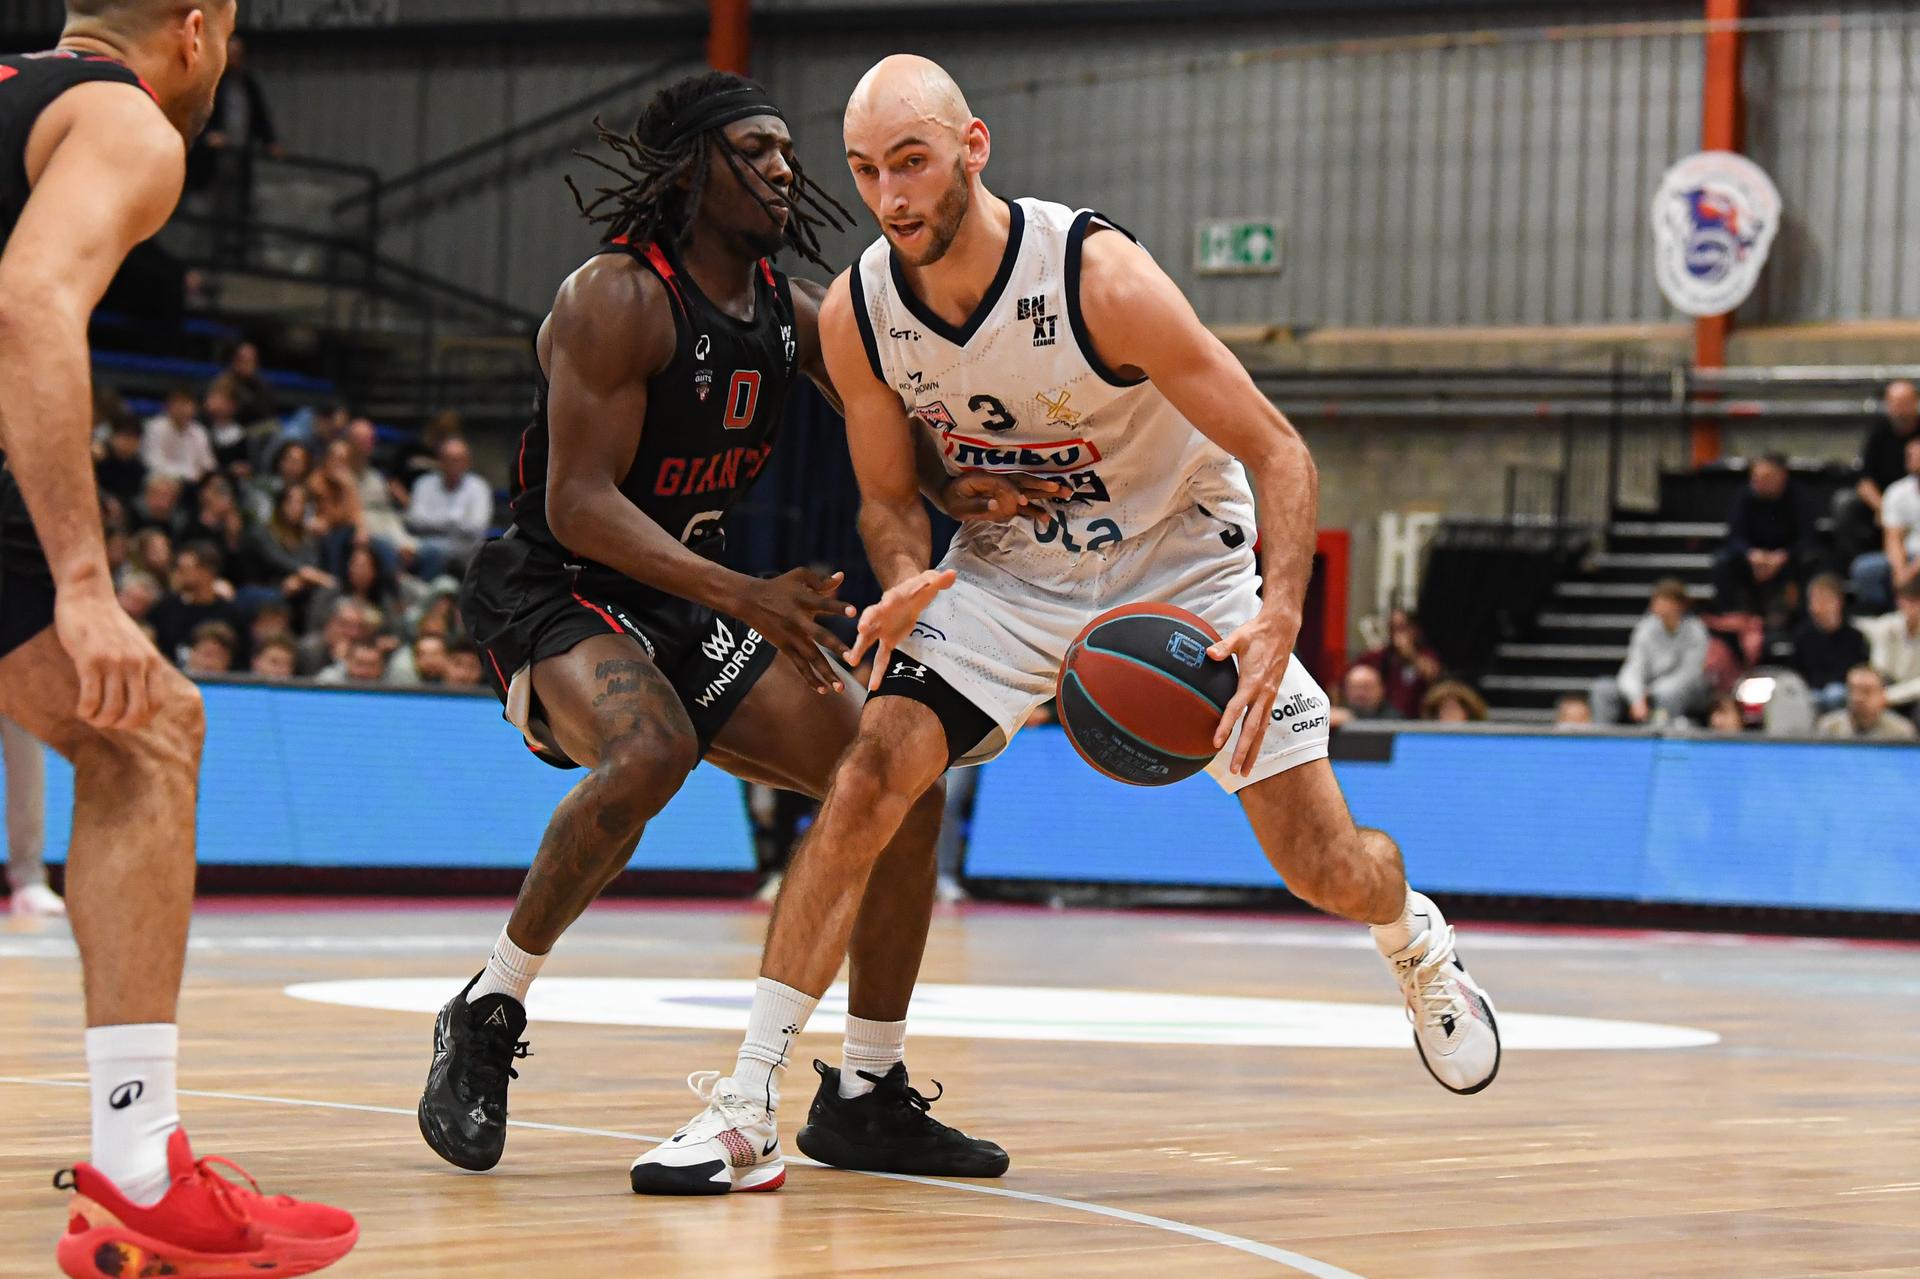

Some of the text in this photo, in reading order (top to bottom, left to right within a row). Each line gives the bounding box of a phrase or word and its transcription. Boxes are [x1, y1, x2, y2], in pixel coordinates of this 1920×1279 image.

[1032, 338, 1056, 347] LEAGUE
[967, 394, 1020, 431] 3
[695, 627, 763, 708] WINDROS
[1291, 716, 1325, 732] CRAFT
